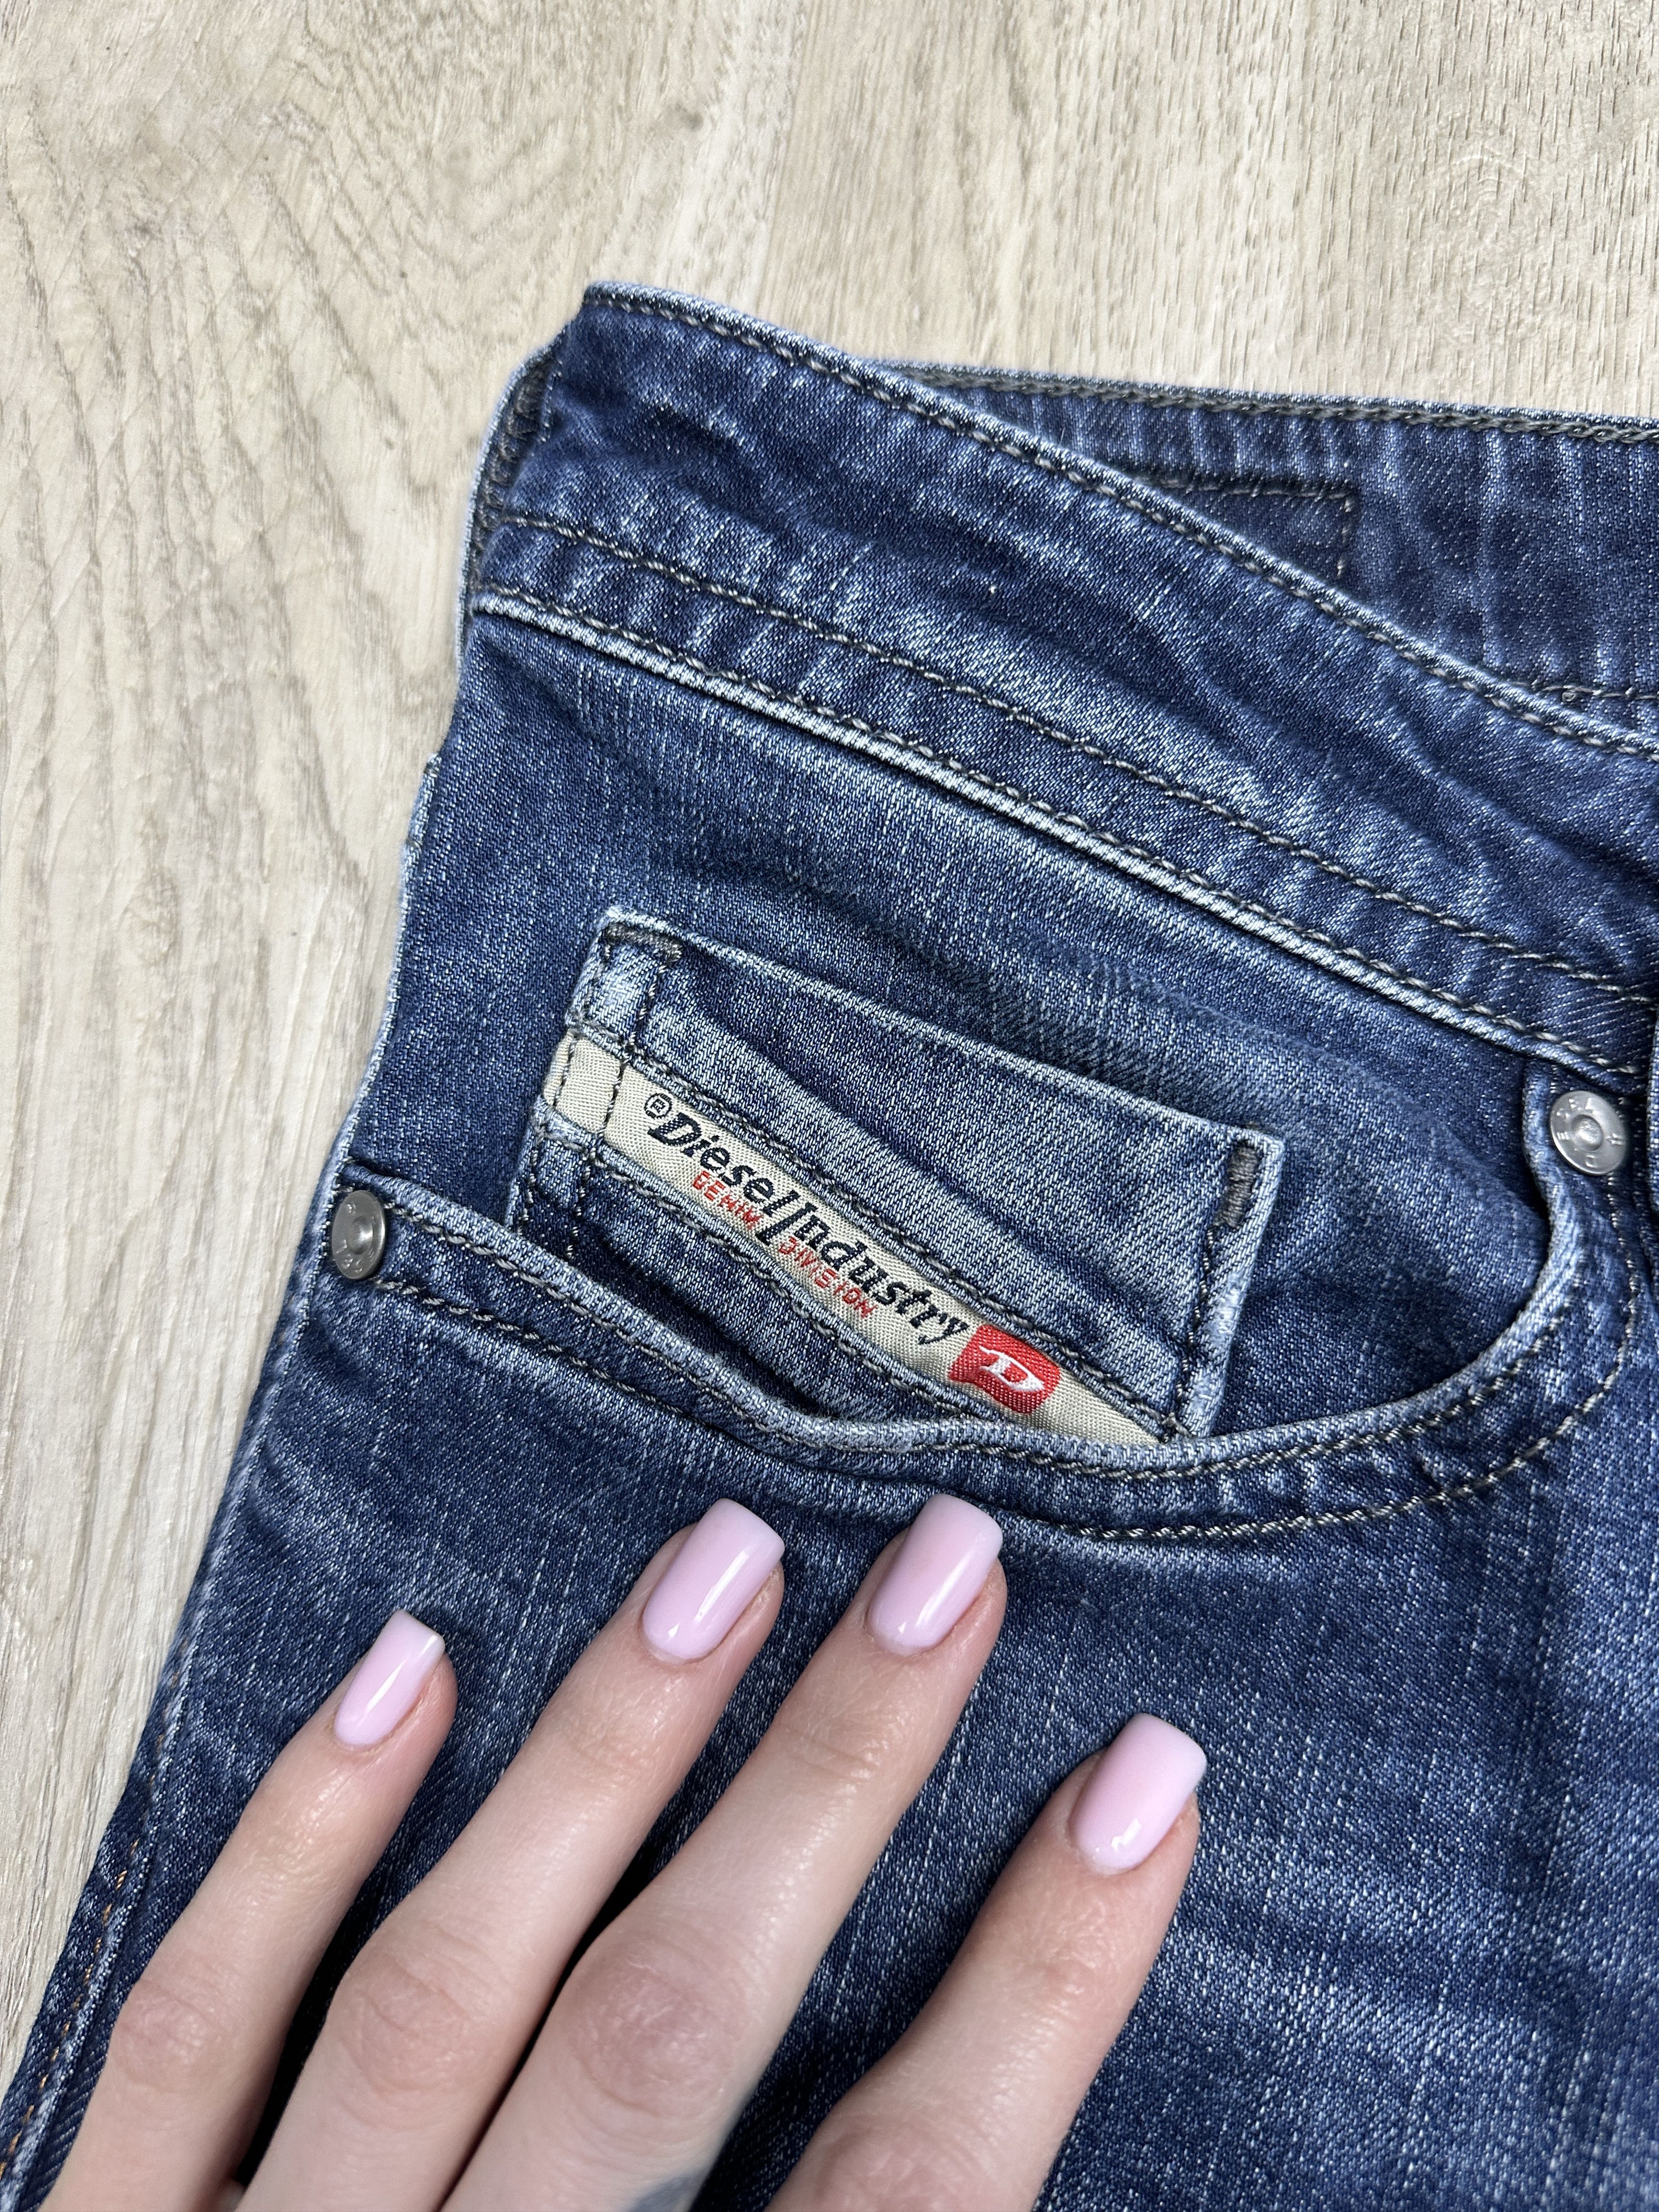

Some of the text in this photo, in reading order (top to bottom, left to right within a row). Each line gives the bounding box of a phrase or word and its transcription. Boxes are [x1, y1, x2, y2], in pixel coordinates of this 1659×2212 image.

[692, 1170, 878, 1319] DENIM DIVISION
[978, 1345, 1045, 1392] D
